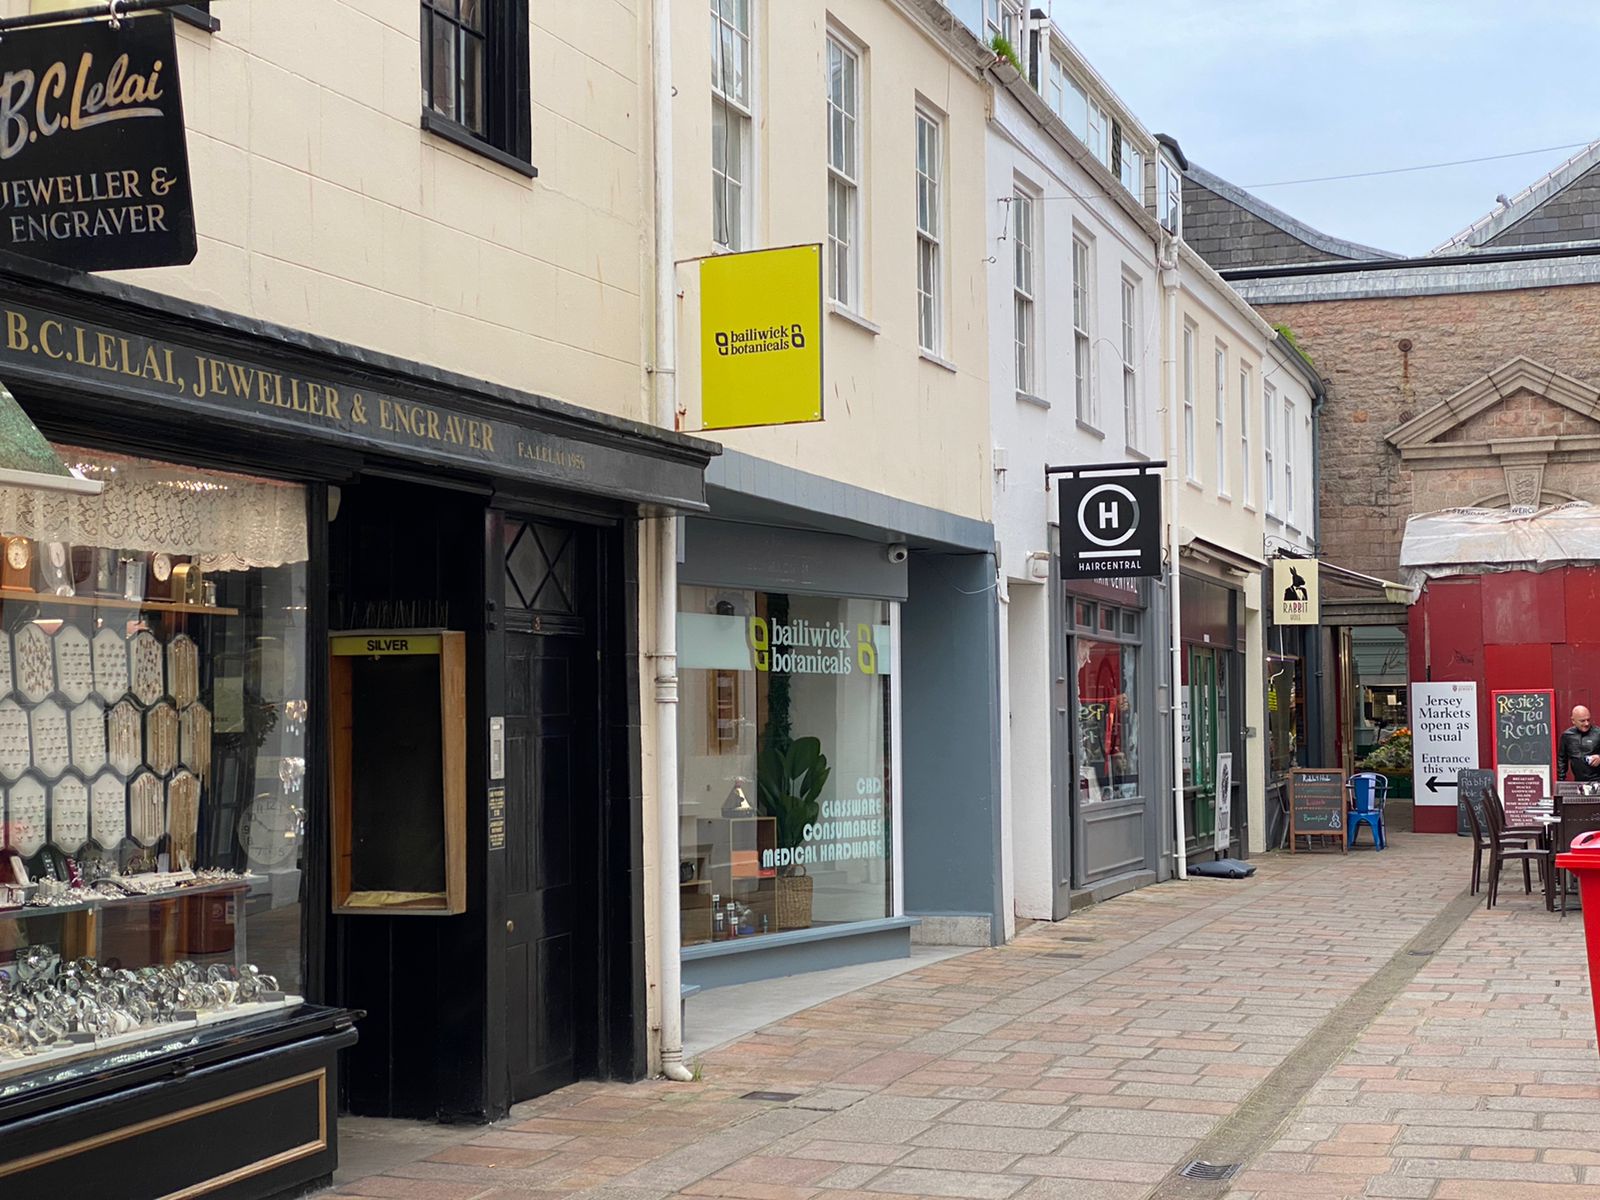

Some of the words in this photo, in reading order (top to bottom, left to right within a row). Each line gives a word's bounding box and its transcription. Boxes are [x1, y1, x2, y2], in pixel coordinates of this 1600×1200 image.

[0, 170, 142, 211] JEWELLER
[151, 167, 177, 196] &
[10, 204, 170, 243] ENGRAVER
[730, 325, 789, 343] bailiwick
[730, 338, 790, 356] botanicals
[192, 355, 342, 420] JEWELLER
[352, 393, 368, 425] &
[379, 399, 495, 452] ENGRAVER
[1099, 501, 1119, 529] H
[1078, 560, 1142, 572] HAIRCENTRAL
[1283, 602, 1308, 614] RABBIT
[771, 617, 851, 649] bailiwick
[367, 640, 408, 651] SILVER
[771, 647, 852, 675] botanicals
[1425, 695, 1462, 708] Jersey
[1496, 694, 1544, 714] Rosie's
[1419, 707, 1470, 718] Markets
[1420, 722, 1450, 732] open
[1456, 722, 1470, 730] as
[1429, 730, 1462, 742] usual
[1422, 754, 1470, 763] Entrance
[1424, 764, 1444, 774] this
[856, 777, 880, 794] CBD
[822, 798, 881, 818] GLASSWARE
[802, 819, 881, 841] CONSUMABLES
[762, 845, 818, 868] MEDICAL
[820, 840, 883, 862] HARDWARE
